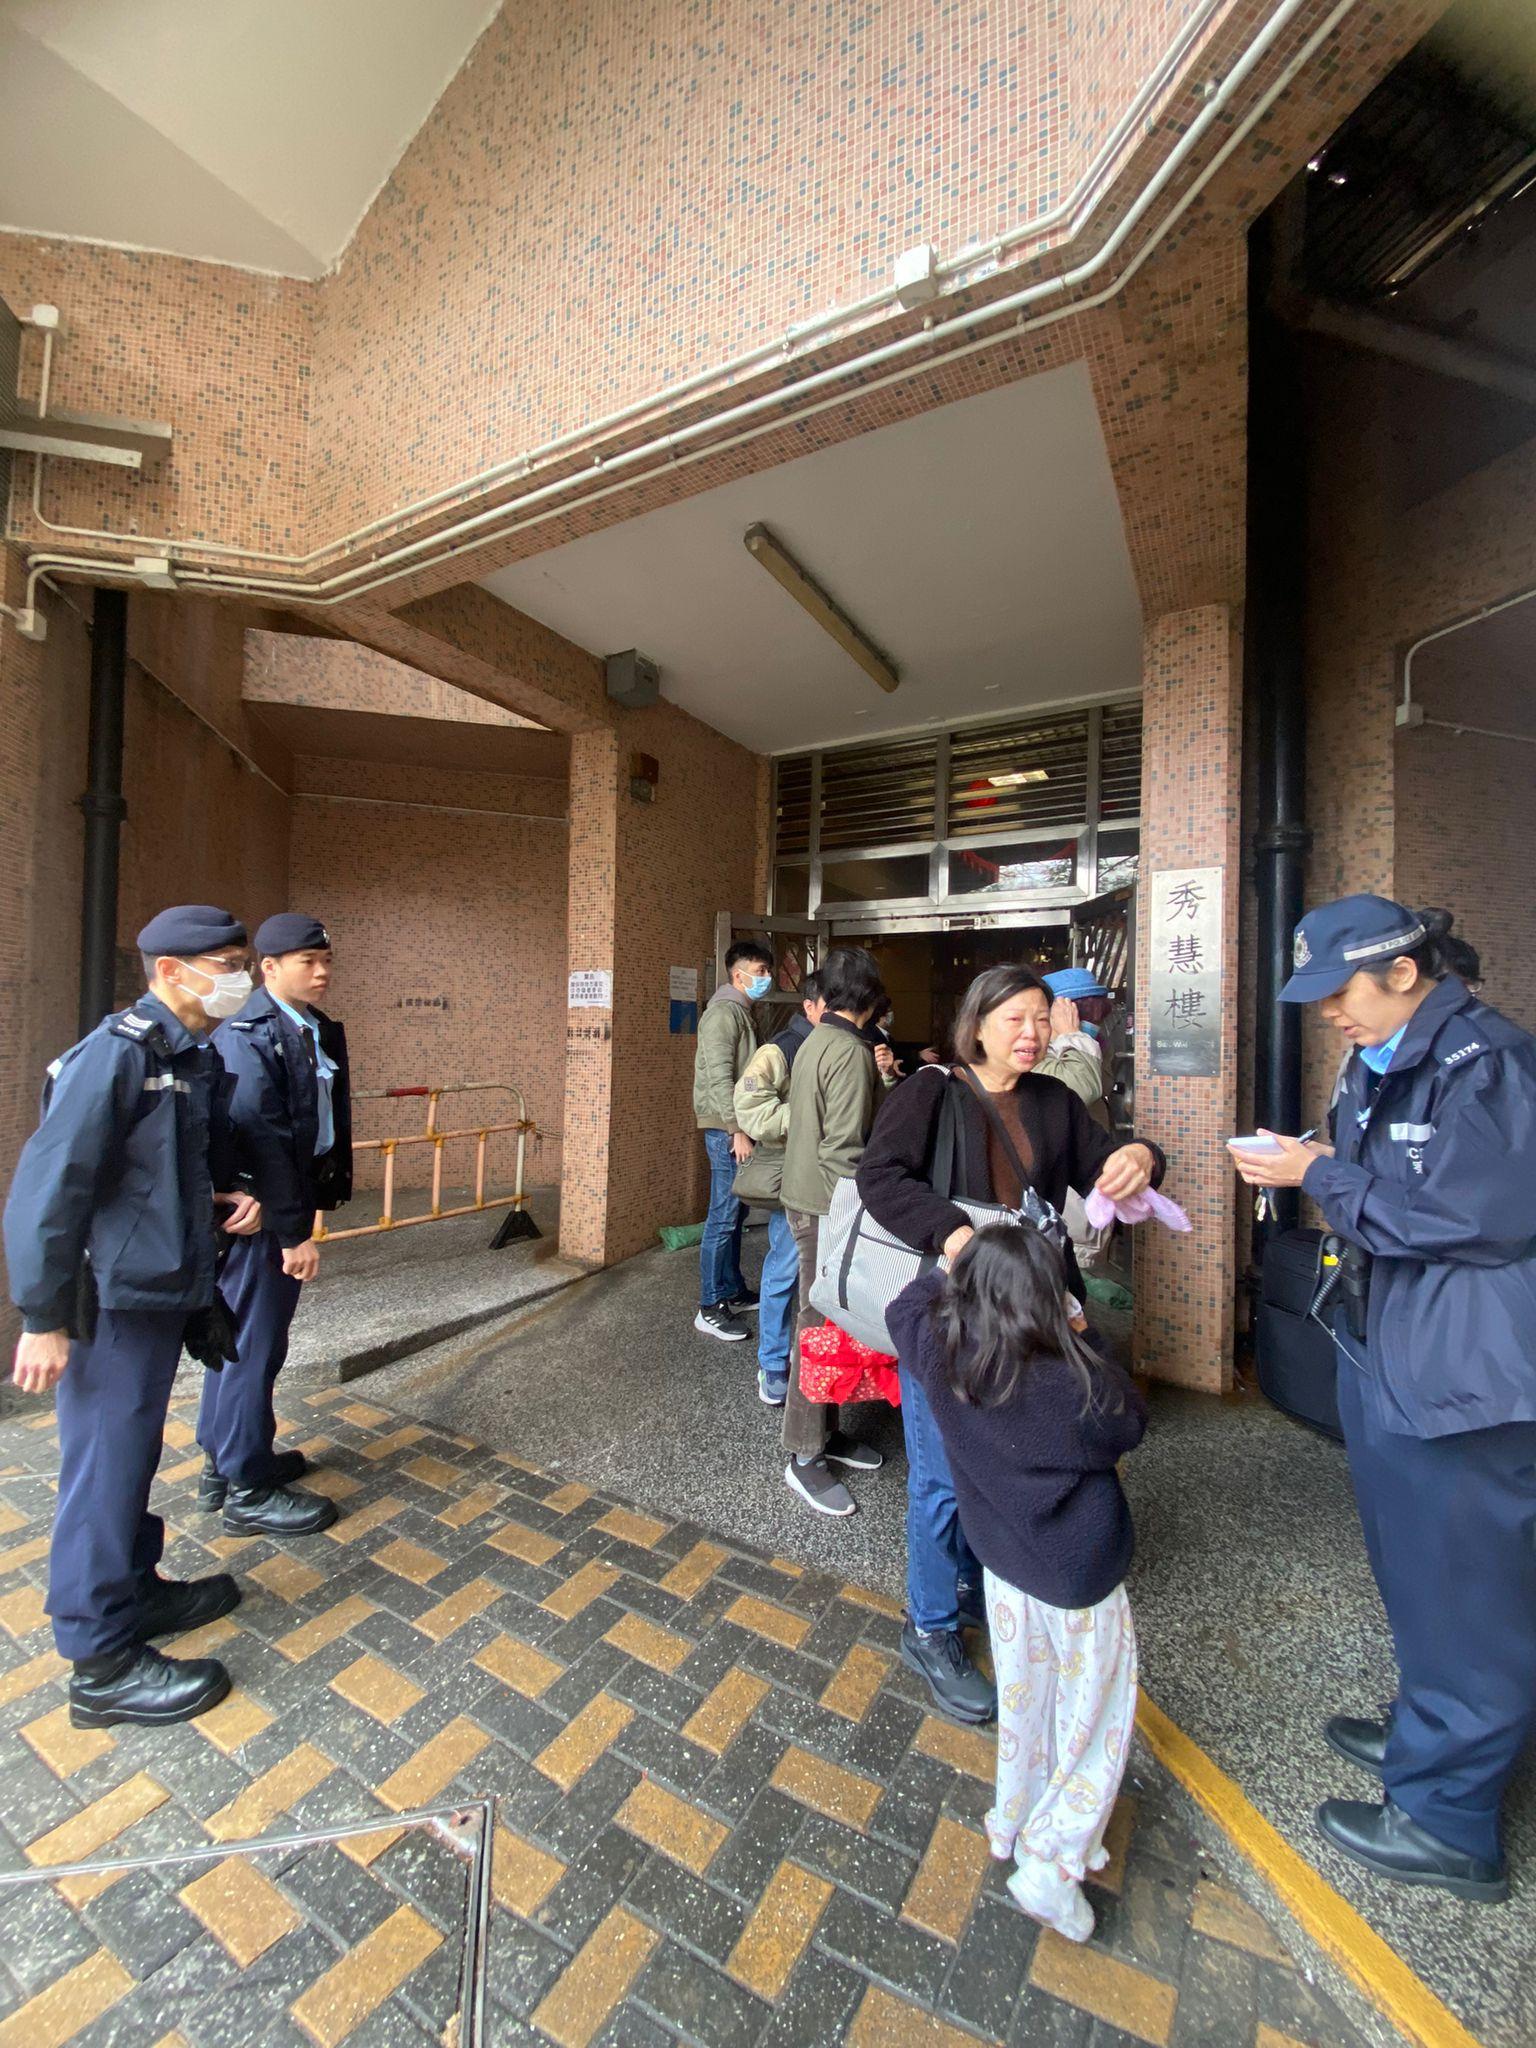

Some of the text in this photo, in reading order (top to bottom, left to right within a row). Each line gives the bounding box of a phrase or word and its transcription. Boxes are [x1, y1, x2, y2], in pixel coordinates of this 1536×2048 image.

[1164, 878, 1207, 1030] 秀慧樓
[1444, 1042, 1480, 1065] 35174
